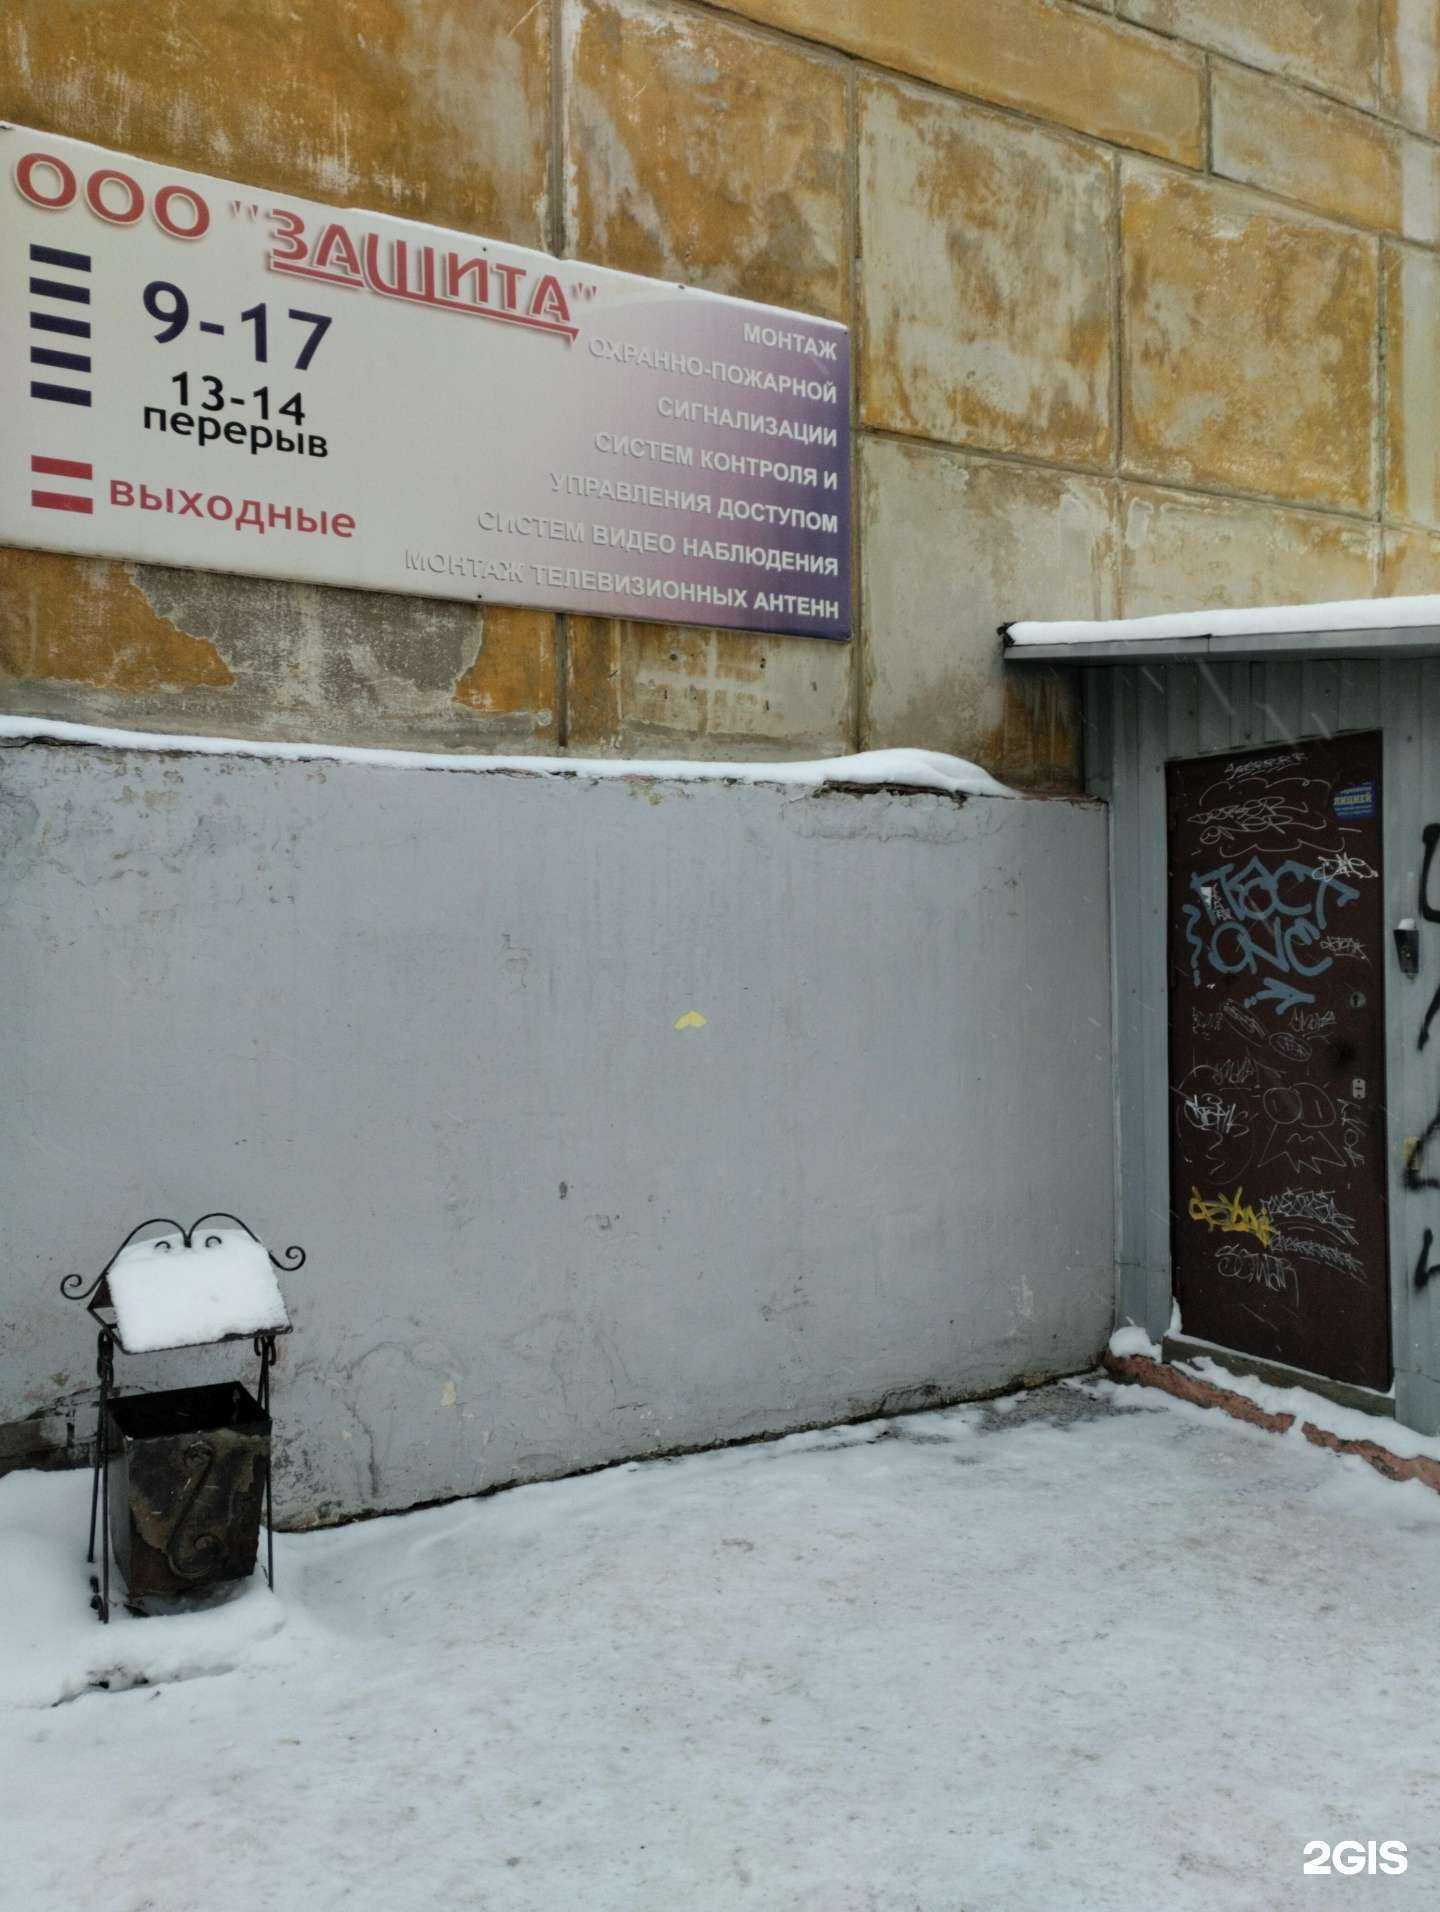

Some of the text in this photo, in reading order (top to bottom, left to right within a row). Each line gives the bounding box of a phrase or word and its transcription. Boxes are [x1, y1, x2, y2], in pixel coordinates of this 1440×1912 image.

[14, 152, 211, 241] ООО
[142, 281, 333, 371] 9-17
[743, 322, 838, 361] МОНТАЖ
[171, 372, 306, 426] 13-14
[588, 336, 837, 404] ОХРАННО-ПОЖАРНОЙ
[143, 405, 329, 458] перерыв
[656, 396, 837, 447] СИГНАЛИЗАЦИИ
[594, 431, 838, 491] СИСТЕМ КОНТРОЛЯ И
[109, 479, 356, 538] выходные
[549, 472, 838, 534] УПРАВЛЕНИЯ ДОСТУПОМ
[477, 511, 839, 577] СИСТЕМ ВИДЕО НАБЛЮДЕНИЯ
[404, 549, 840, 620] МОНТАЖ ТЕЛЕВИЗИОННЫХ АНТЕНН
